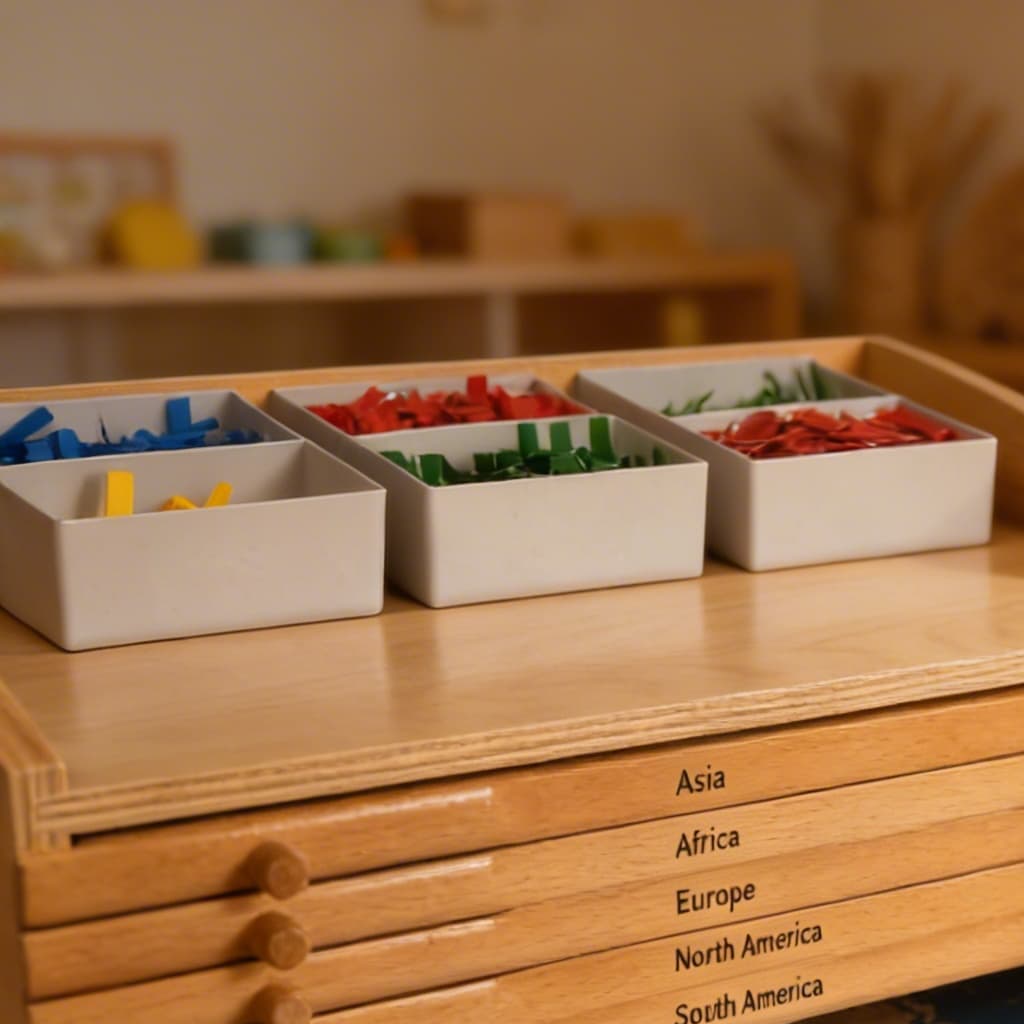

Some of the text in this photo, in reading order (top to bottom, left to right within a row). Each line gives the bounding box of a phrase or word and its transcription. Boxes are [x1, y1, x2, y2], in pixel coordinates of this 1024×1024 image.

[675, 765, 726, 796] Asia
[675, 827, 741, 859] Africa
[675, 883, 756, 915] Europe
[674, 921, 823, 972] North America
[741, 976, 824, 1015] America
